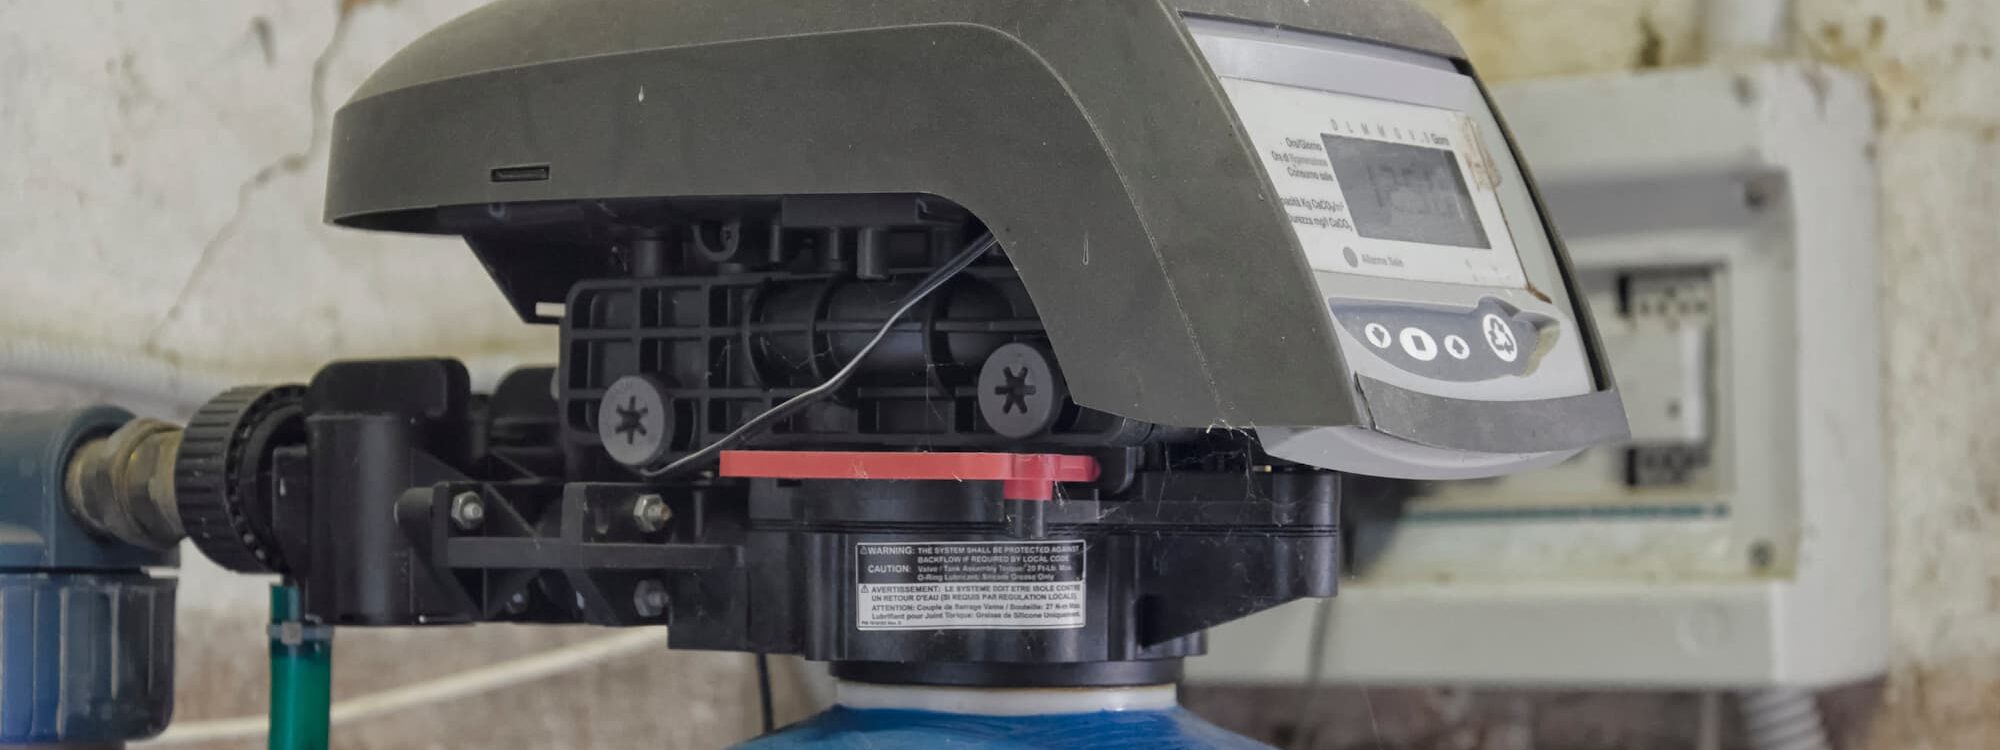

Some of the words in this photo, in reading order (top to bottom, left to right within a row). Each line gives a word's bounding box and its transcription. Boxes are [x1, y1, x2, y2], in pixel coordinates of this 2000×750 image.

[867, 546, 915, 555] WARNING:
[966, 546, 991, 554] SHALL
[1051, 545, 1080, 553] AGAINST
[917, 556, 962, 564] BACKFLOW
[971, 555, 1009, 563] REQUIRED
[1010, 555, 1021, 563] BY
[1022, 555, 1048, 563] LOCAL
[867, 564, 910, 573] CAUTION:
[917, 565, 938, 573] Valve
[962, 565, 997, 573] Assembly
[917, 574, 943, 582] O-Ring
[1037, 574, 1055, 582] Only
[871, 585, 941, 593] AVERTISSEMENT:
[883, 594, 916, 602] RETOUR
[916, 604, 942, 613] Couple
